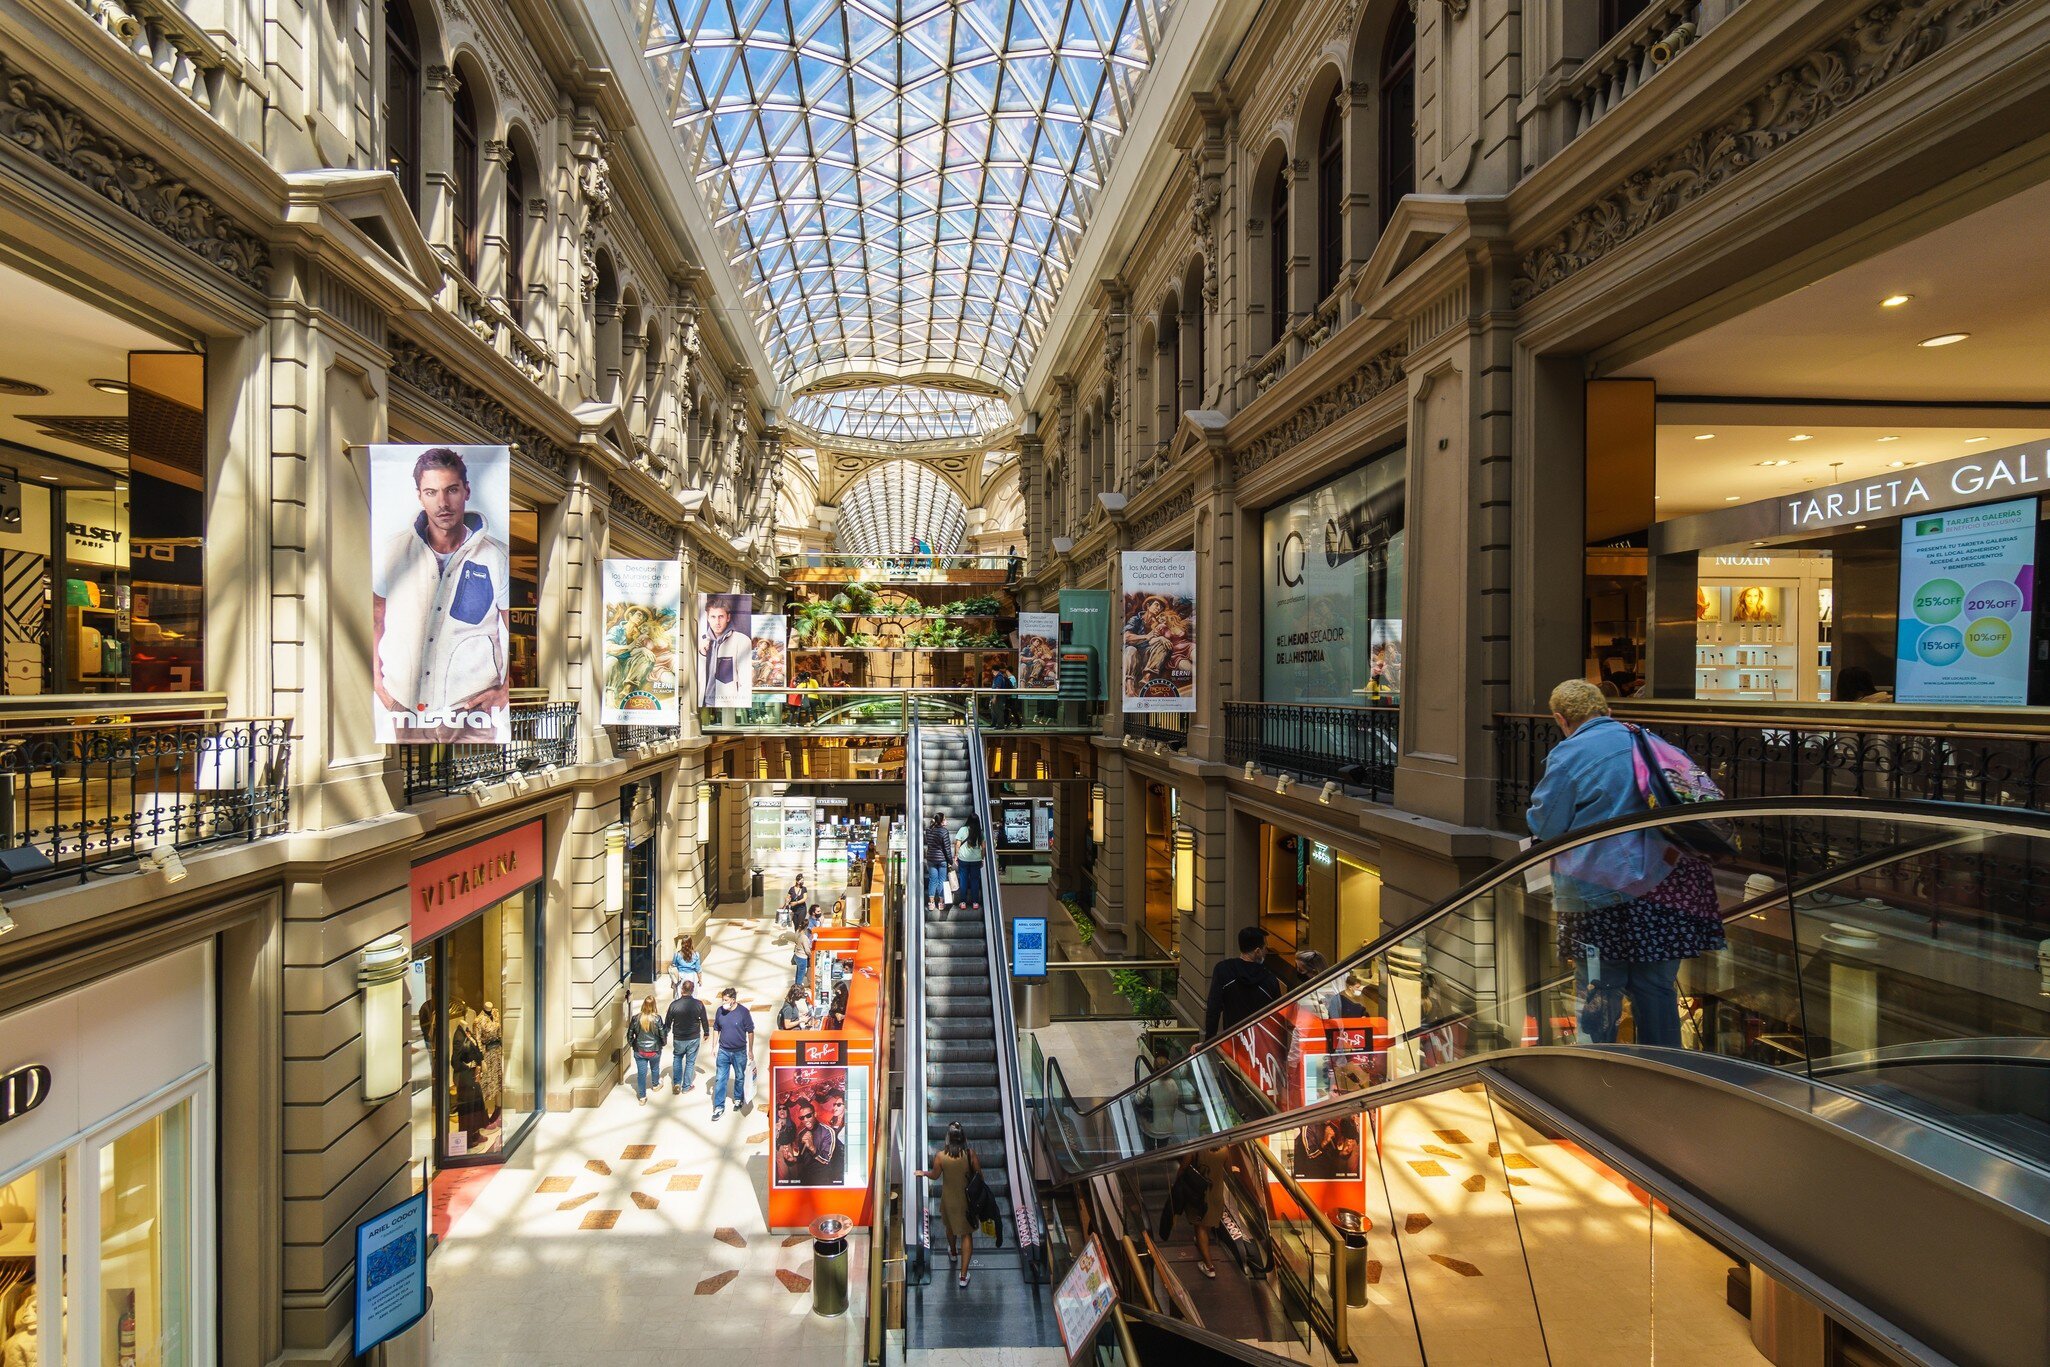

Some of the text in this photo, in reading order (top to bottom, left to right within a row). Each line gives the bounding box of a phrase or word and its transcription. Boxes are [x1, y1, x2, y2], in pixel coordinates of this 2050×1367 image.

[1788, 476, 1930, 526] TARJETA
[1945, 513, 1980, 526] TARJETA
[1945, 517, 2022, 533] BENEFICIO EXCLUSIVO
[75, 540, 104, 549] PARIS
[1957, 540, 1985, 548] TARJETA
[1944, 549, 1964, 557] LOCAL
[1965, 545, 2000, 554] ADHERIDO
[1960, 552, 2004, 562] DESCUENTOS
[1132, 572, 1158, 580] Cúpula
[653, 681, 673, 689] BERNI
[386, 703, 506, 729] mistral
[420, 850, 517, 913] VITAMINA
[368, 1223, 391, 1239] ARIEL
[391, 1207, 418, 1226] GODOY
